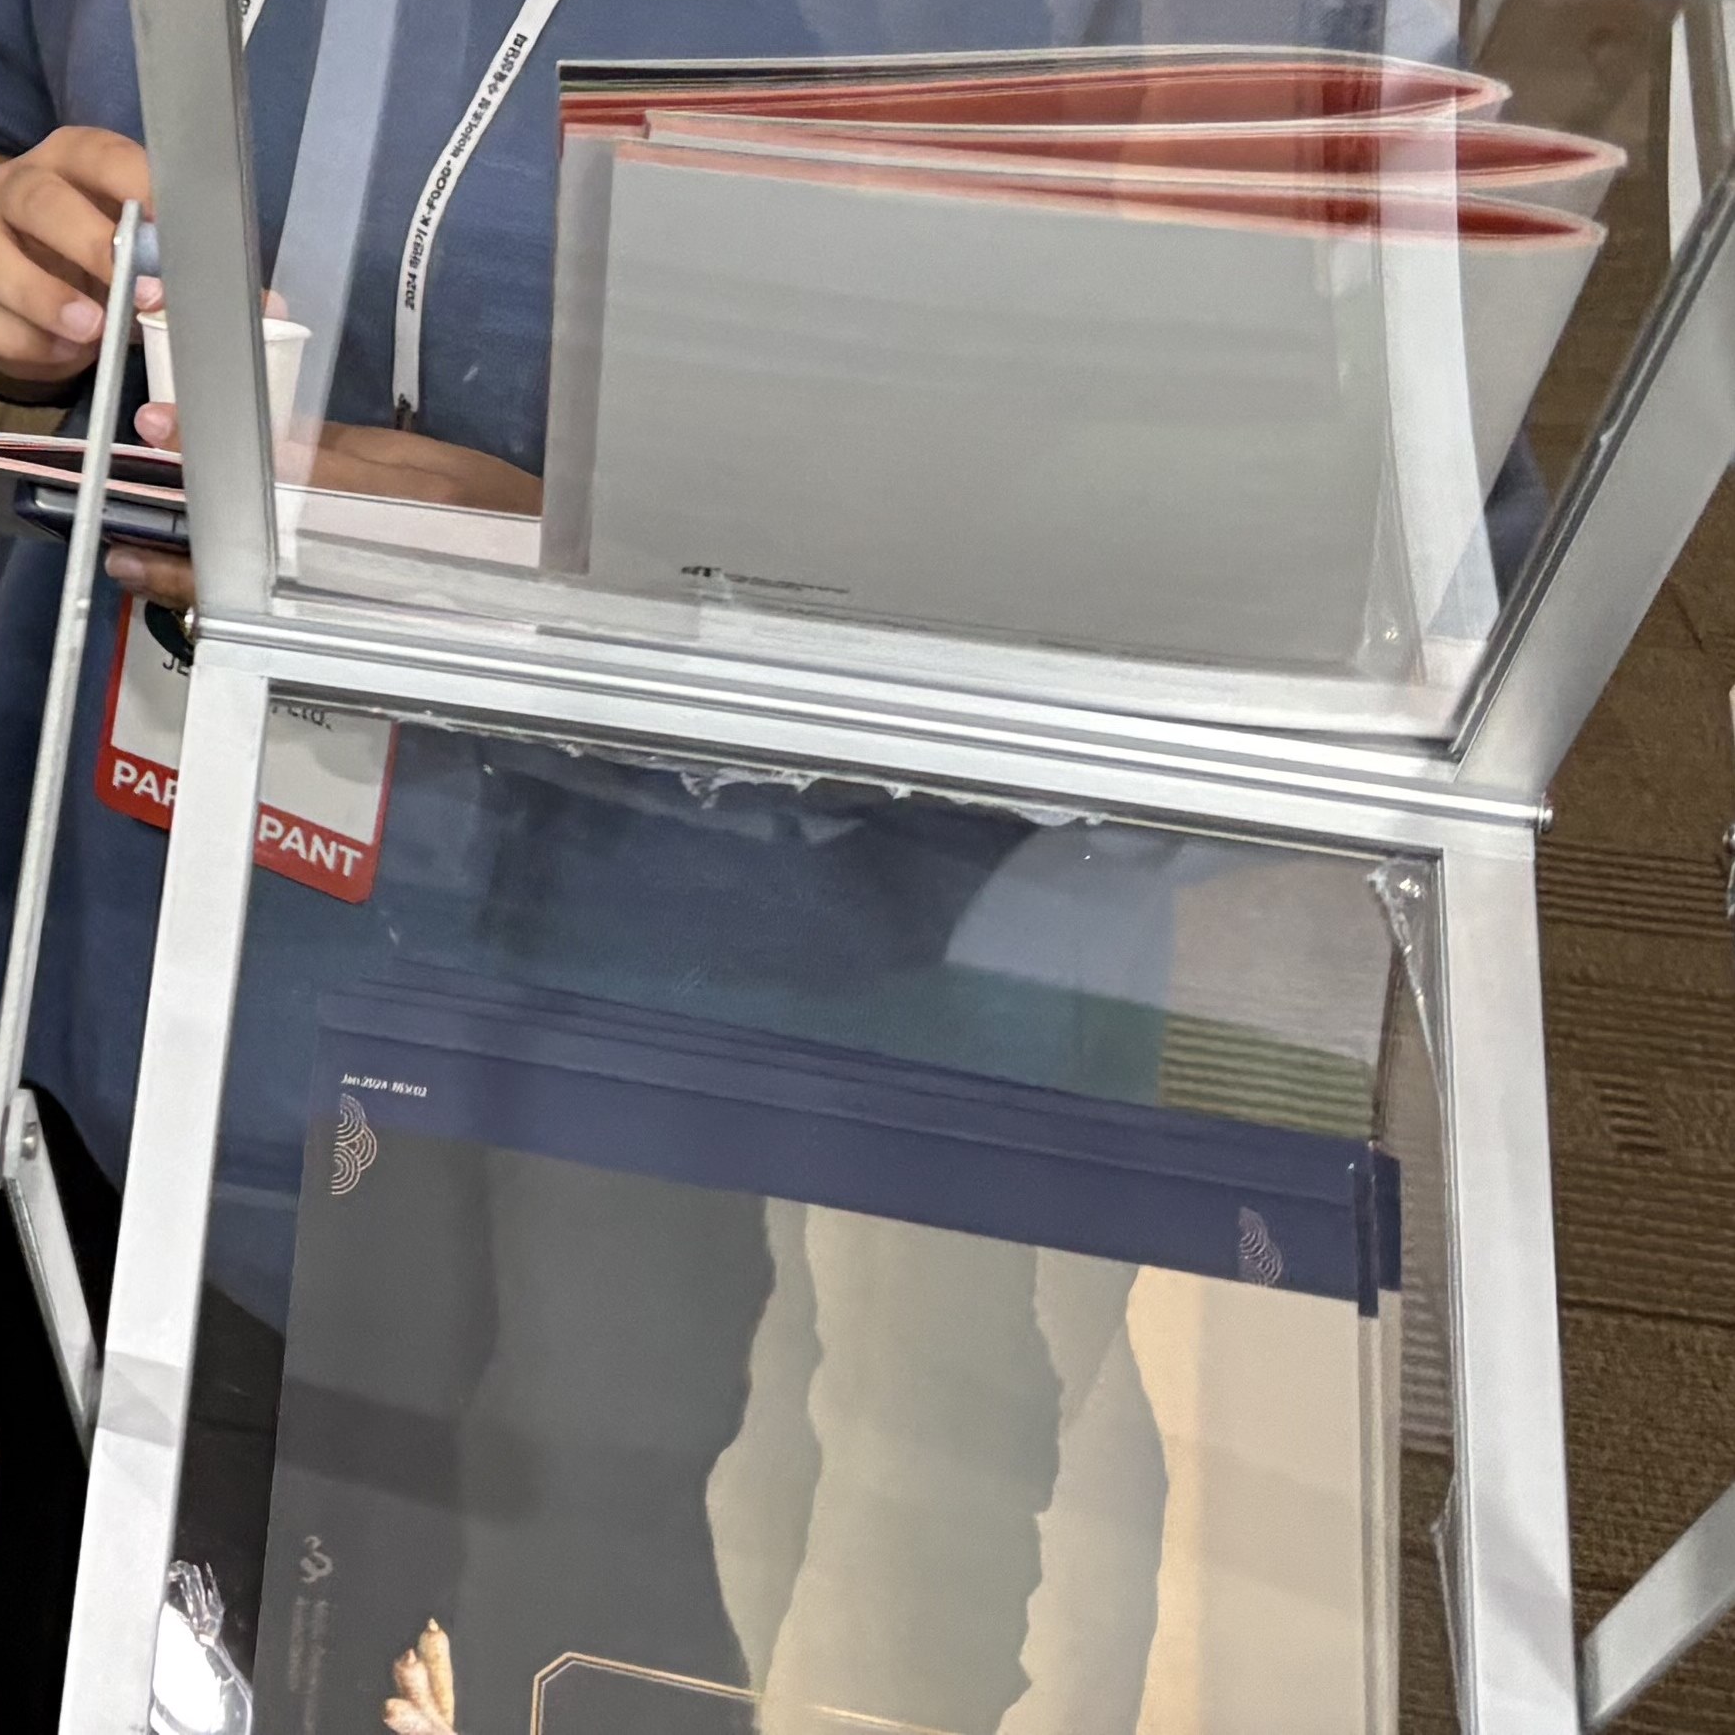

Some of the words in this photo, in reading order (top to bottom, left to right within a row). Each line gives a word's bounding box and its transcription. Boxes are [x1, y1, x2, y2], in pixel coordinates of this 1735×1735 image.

[404, 272, 418, 312] 2024
[449, 96, 492, 159] 바이어초청
[487, 32, 530, 96] 수출상담회
